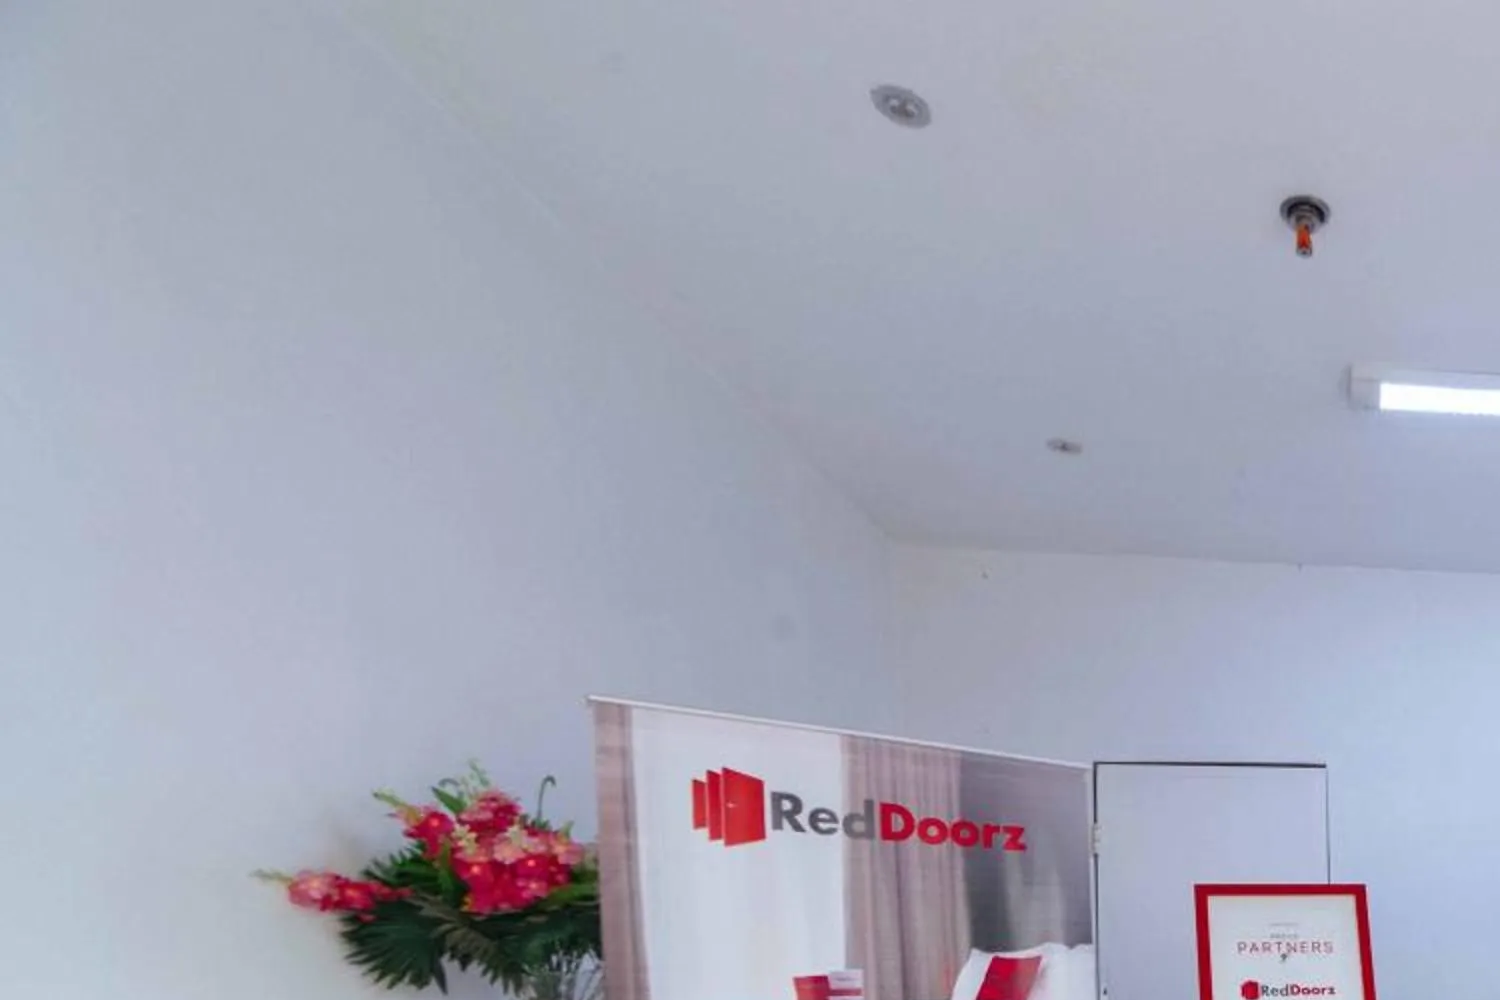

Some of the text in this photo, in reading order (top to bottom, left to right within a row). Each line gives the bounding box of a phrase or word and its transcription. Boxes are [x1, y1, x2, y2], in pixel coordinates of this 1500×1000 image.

[771, 791, 1027, 852] RedDoorz
[1237, 941, 1334, 954] PARTNERS
[1261, 984, 1336, 997] RedDoorz
